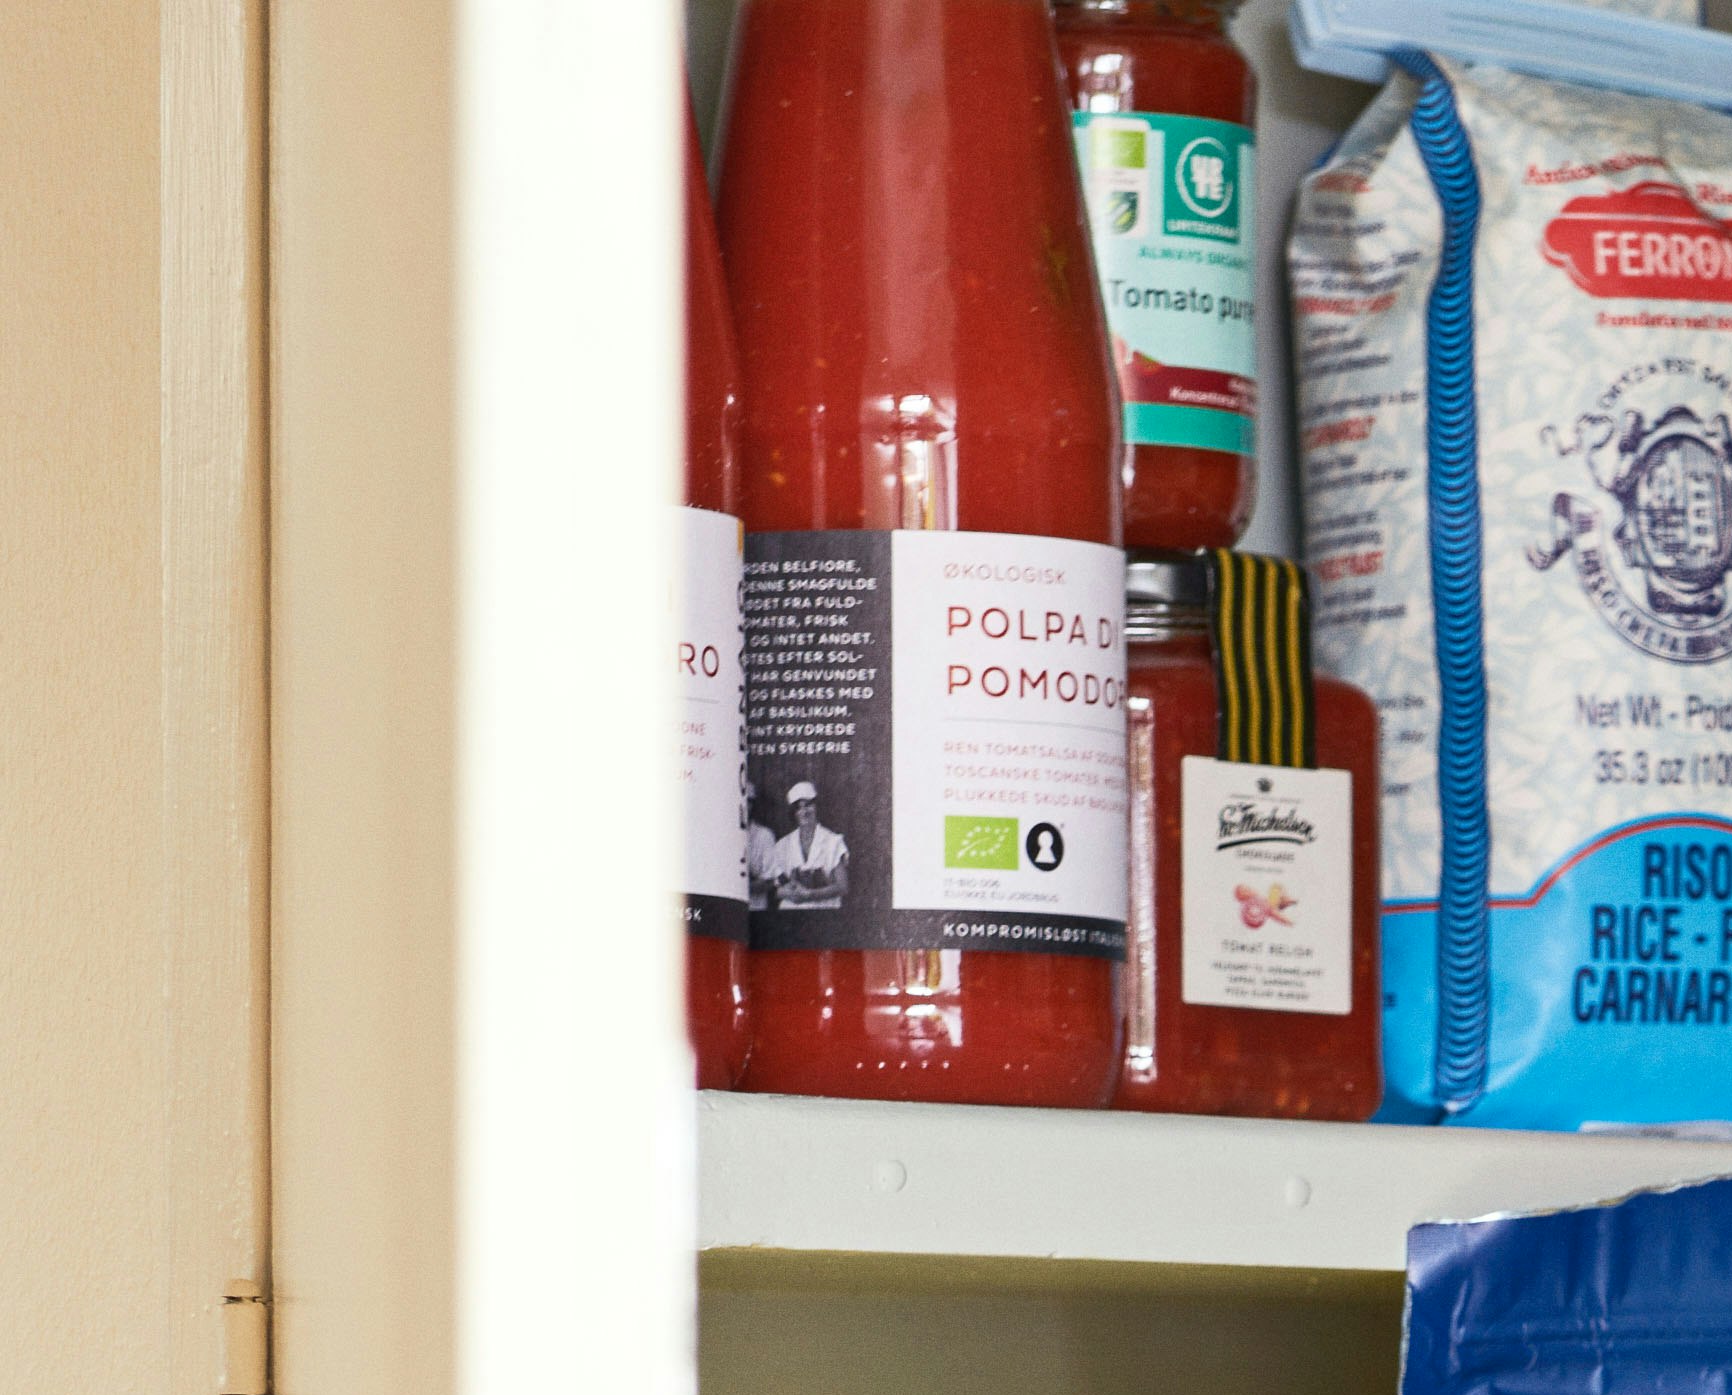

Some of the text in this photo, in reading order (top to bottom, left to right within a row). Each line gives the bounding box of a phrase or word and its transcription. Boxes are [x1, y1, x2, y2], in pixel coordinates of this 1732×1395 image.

[1108, 279, 1213, 315] Tomato
[943, 563, 1067, 585] ØKOLOGISK
[804, 614, 849, 627] FRISK
[947, 606, 1118, 649] POLPA DI
[777, 650, 824, 664] EFTER
[782, 668, 878, 682] GENVUNDET
[771, 687, 835, 700] FLASKES
[838, 687, 874, 699] MED
[1576, 694, 1620, 728] Net
[777, 723, 856, 736] KRYDREDE
[779, 741, 851, 754] SYREFRIE
[945, 765, 1040, 781] TOSCANSKE
[1595, 750, 1650, 787] 35.3
[1657, 758, 1685, 786] oz
[944, 789, 1027, 804] PLUKKEDE
[943, 922, 1088, 942] KOMPROMISLØST
[1591, 905, 1681, 962] RICE
